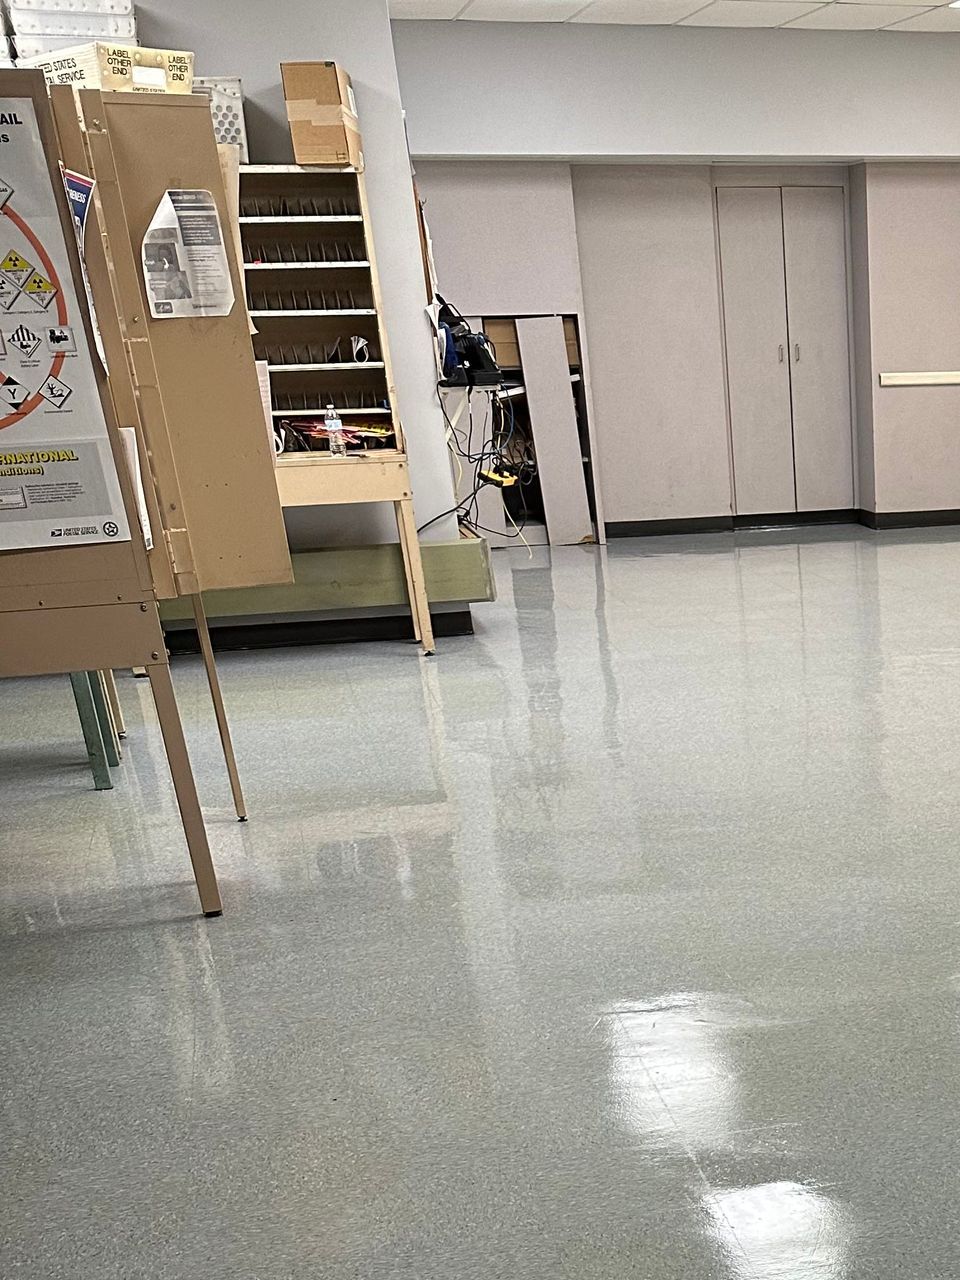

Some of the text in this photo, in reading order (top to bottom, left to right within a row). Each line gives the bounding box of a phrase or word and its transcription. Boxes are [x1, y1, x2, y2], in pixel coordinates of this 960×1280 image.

[107, 48, 131, 59] LABEL
[53, 58, 77, 71] STATES
[107, 58, 132, 68] OTHER
[168, 56, 188, 65] LABEL
[112, 66, 128, 76] END
[168, 64, 189, 73] OTHER
[57, 69, 86, 84] SERVICE
[172, 73, 185, 81] END
